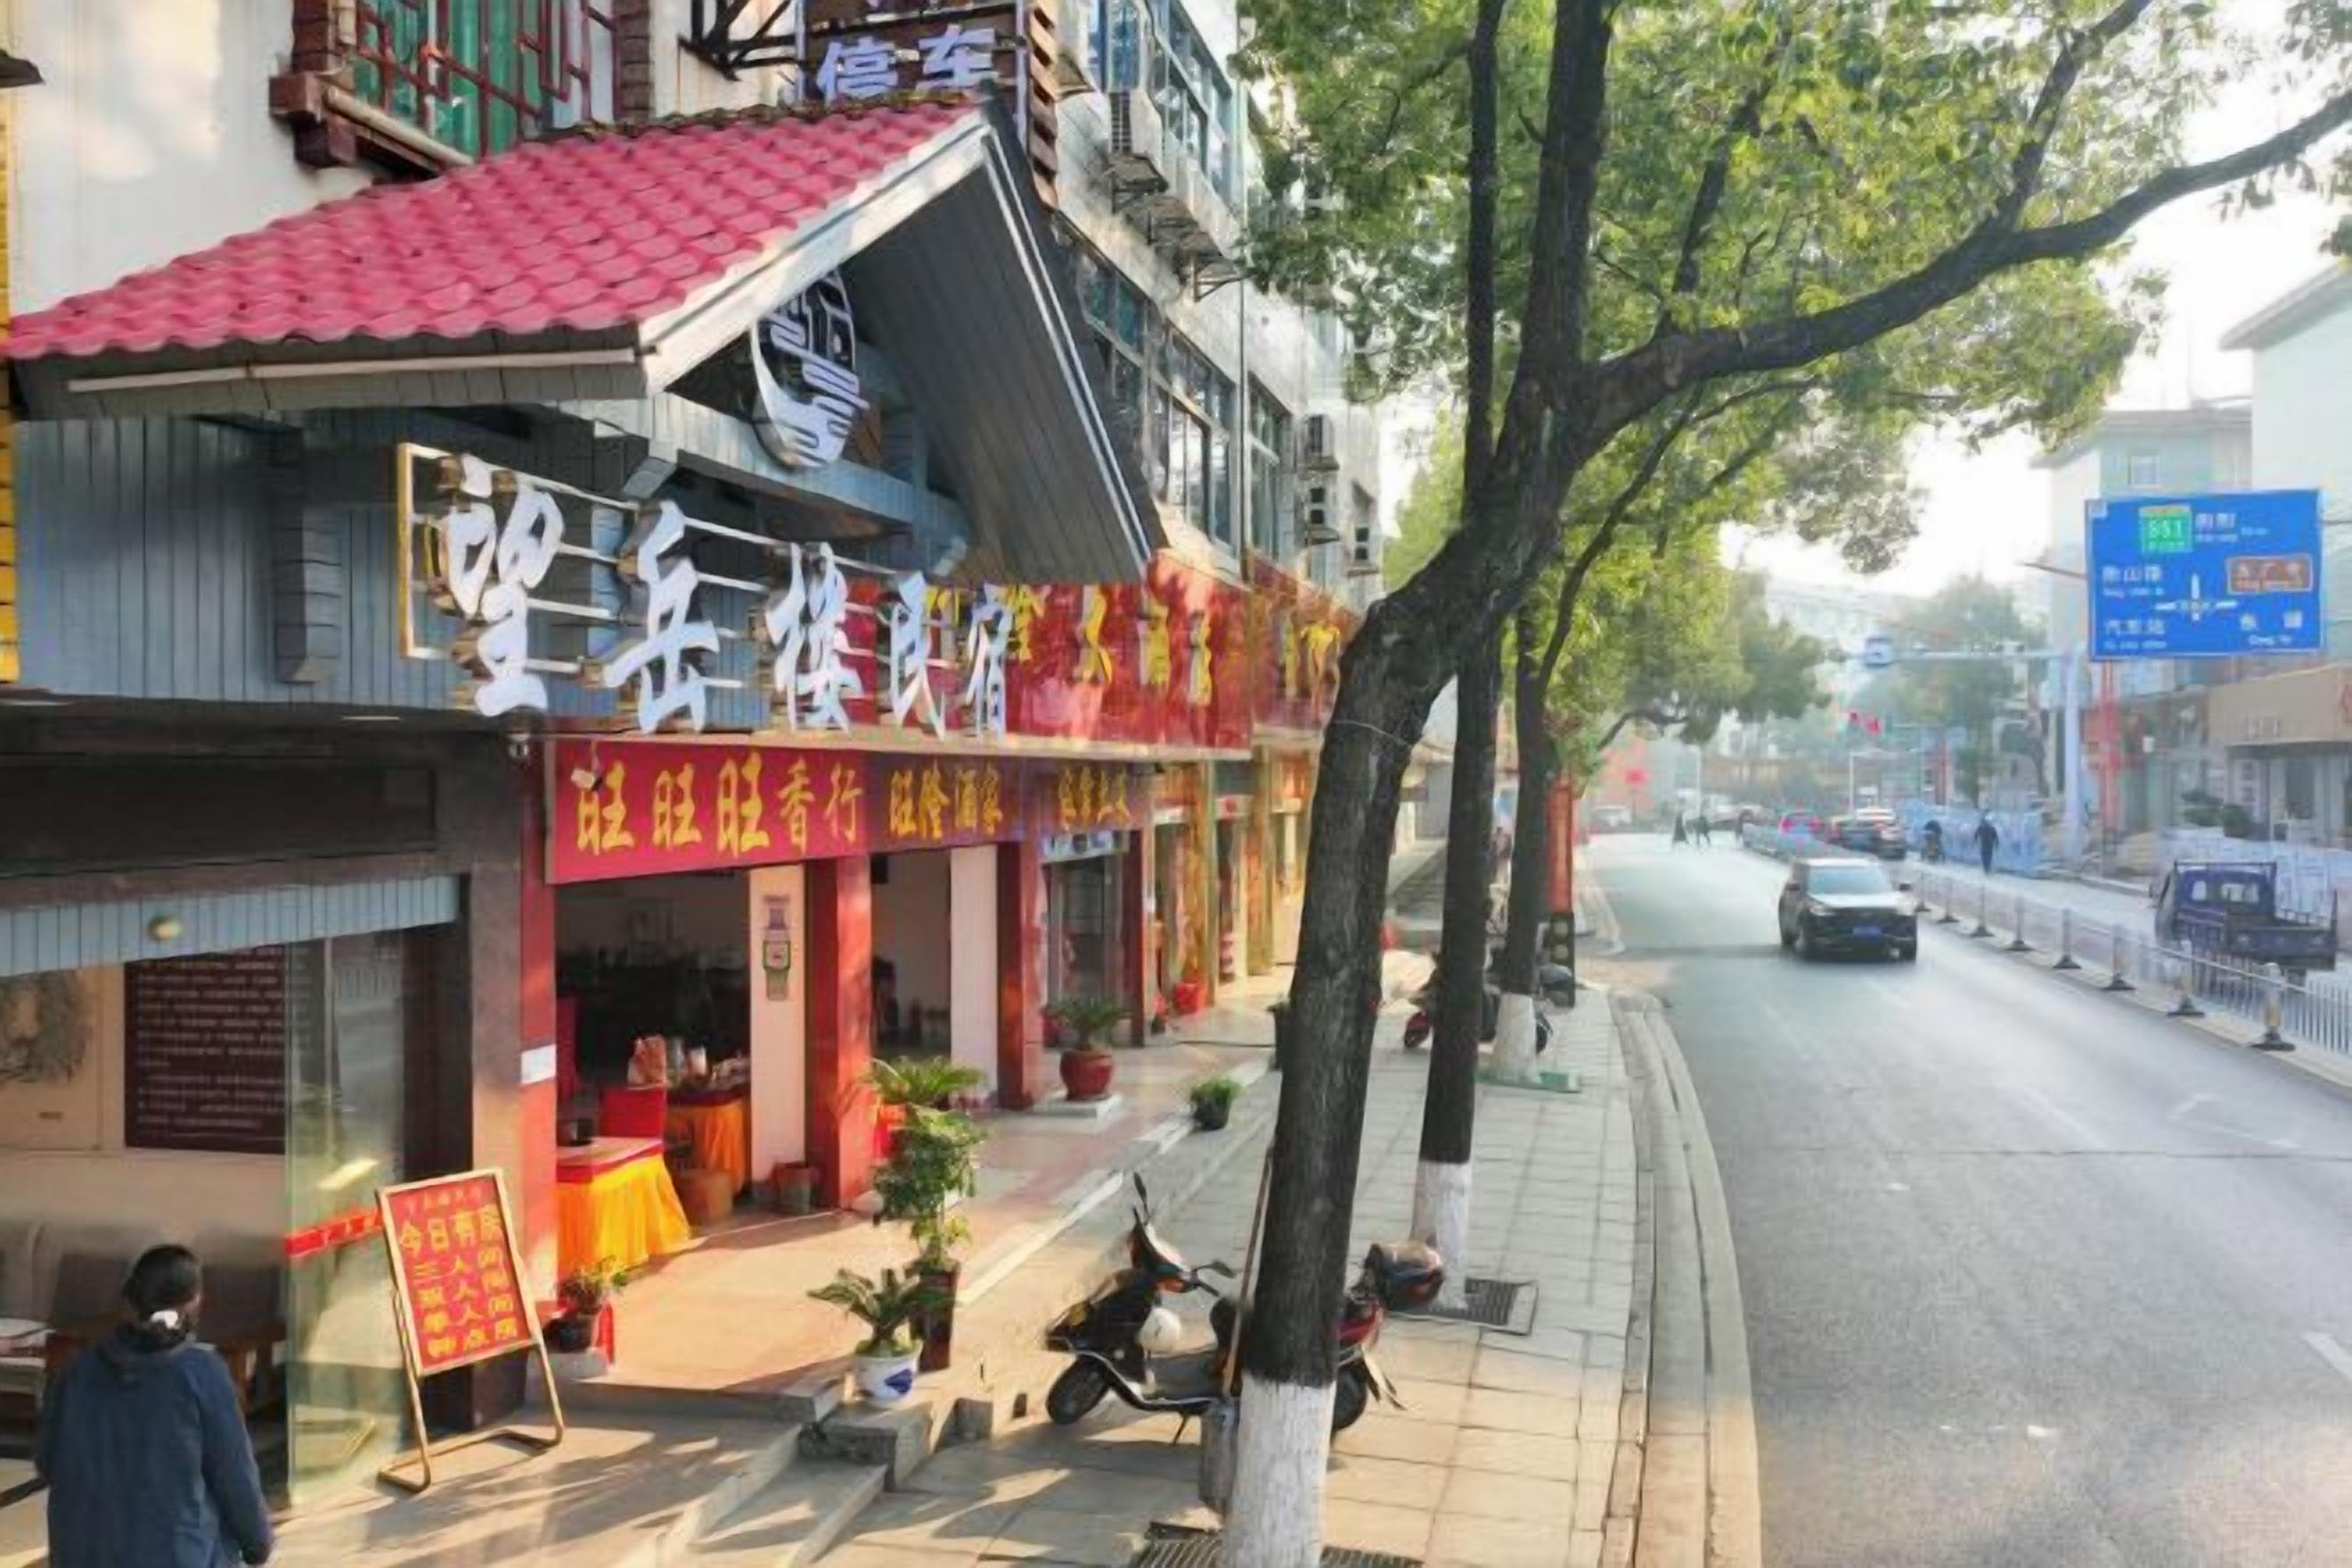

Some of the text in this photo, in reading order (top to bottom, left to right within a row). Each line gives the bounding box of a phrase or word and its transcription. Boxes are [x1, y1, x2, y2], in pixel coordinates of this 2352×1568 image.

[817, 24, 999, 105] 停车
[577, 753, 862, 858] 旺旺旺香行
